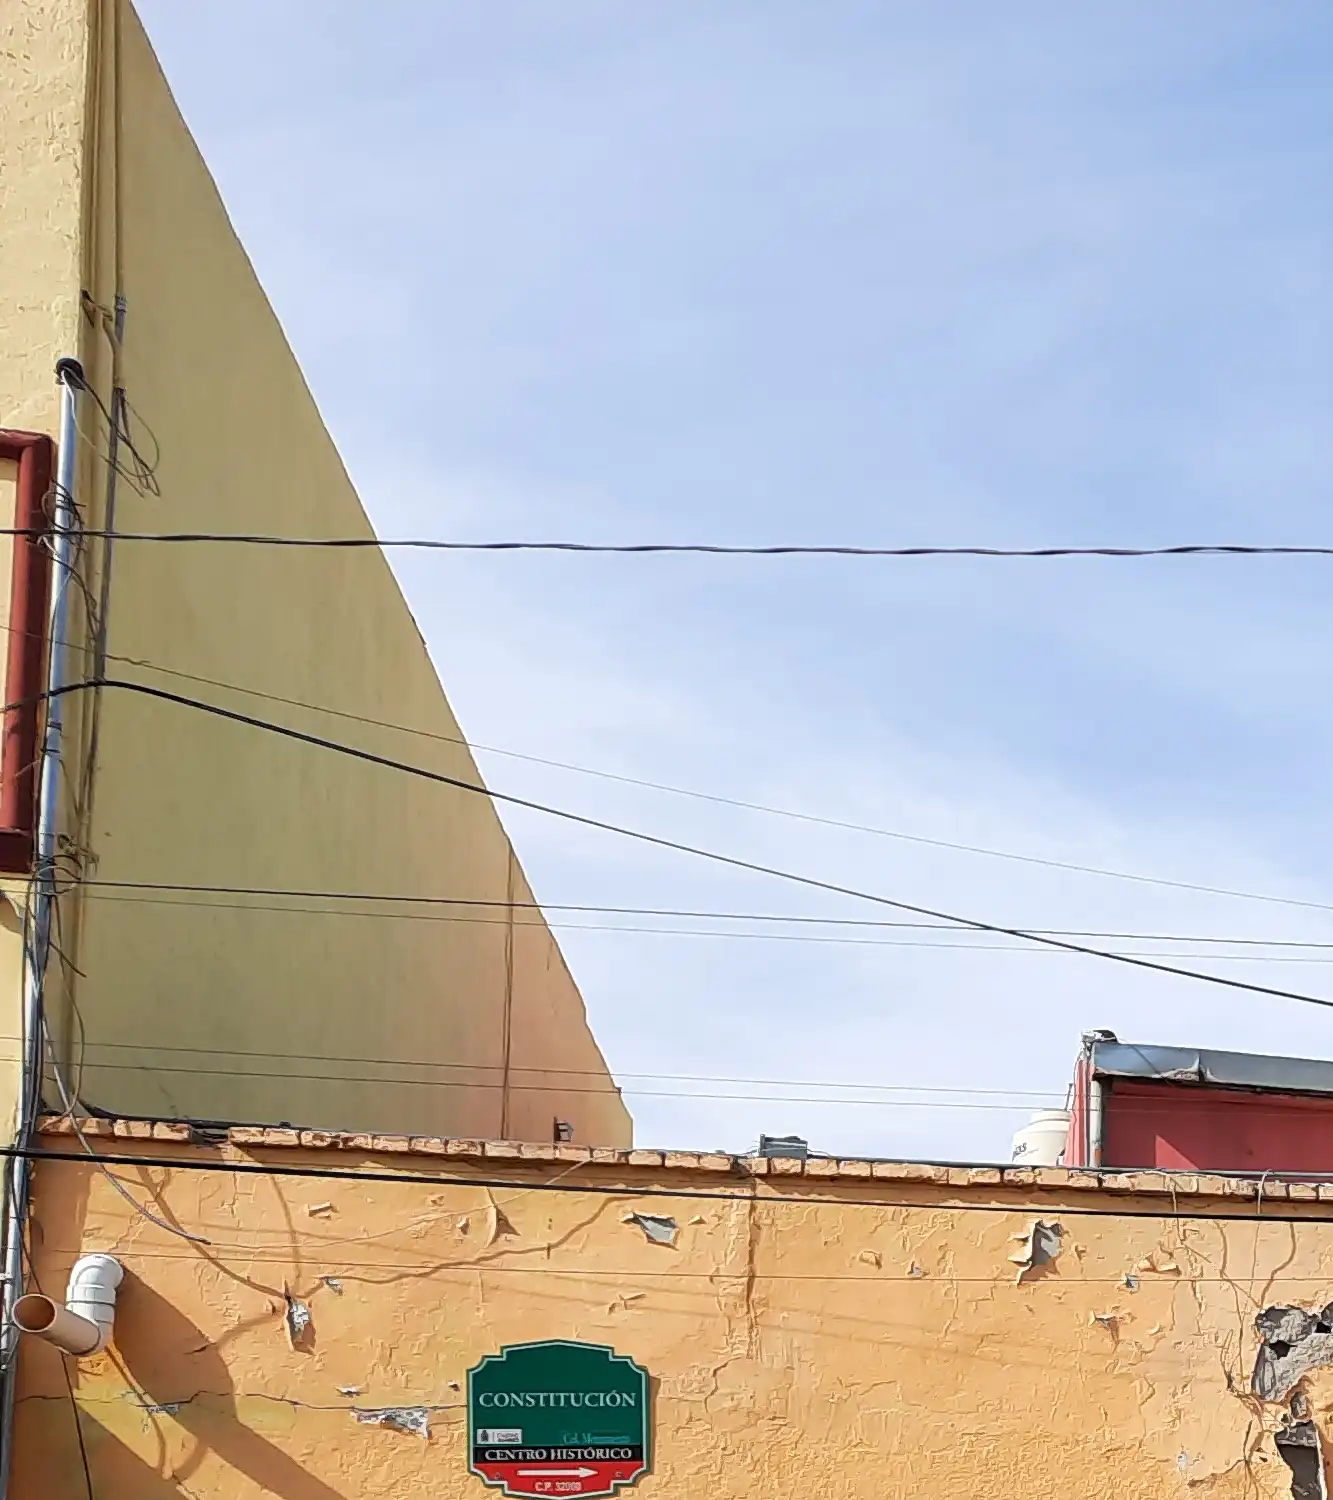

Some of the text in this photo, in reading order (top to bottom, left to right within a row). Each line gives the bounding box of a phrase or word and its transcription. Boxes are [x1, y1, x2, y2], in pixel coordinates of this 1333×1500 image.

[478, 1389, 637, 1408] CONSTITUCIÓN
[485, 1446, 633, 1461] CENTRO HISTÓRICO
